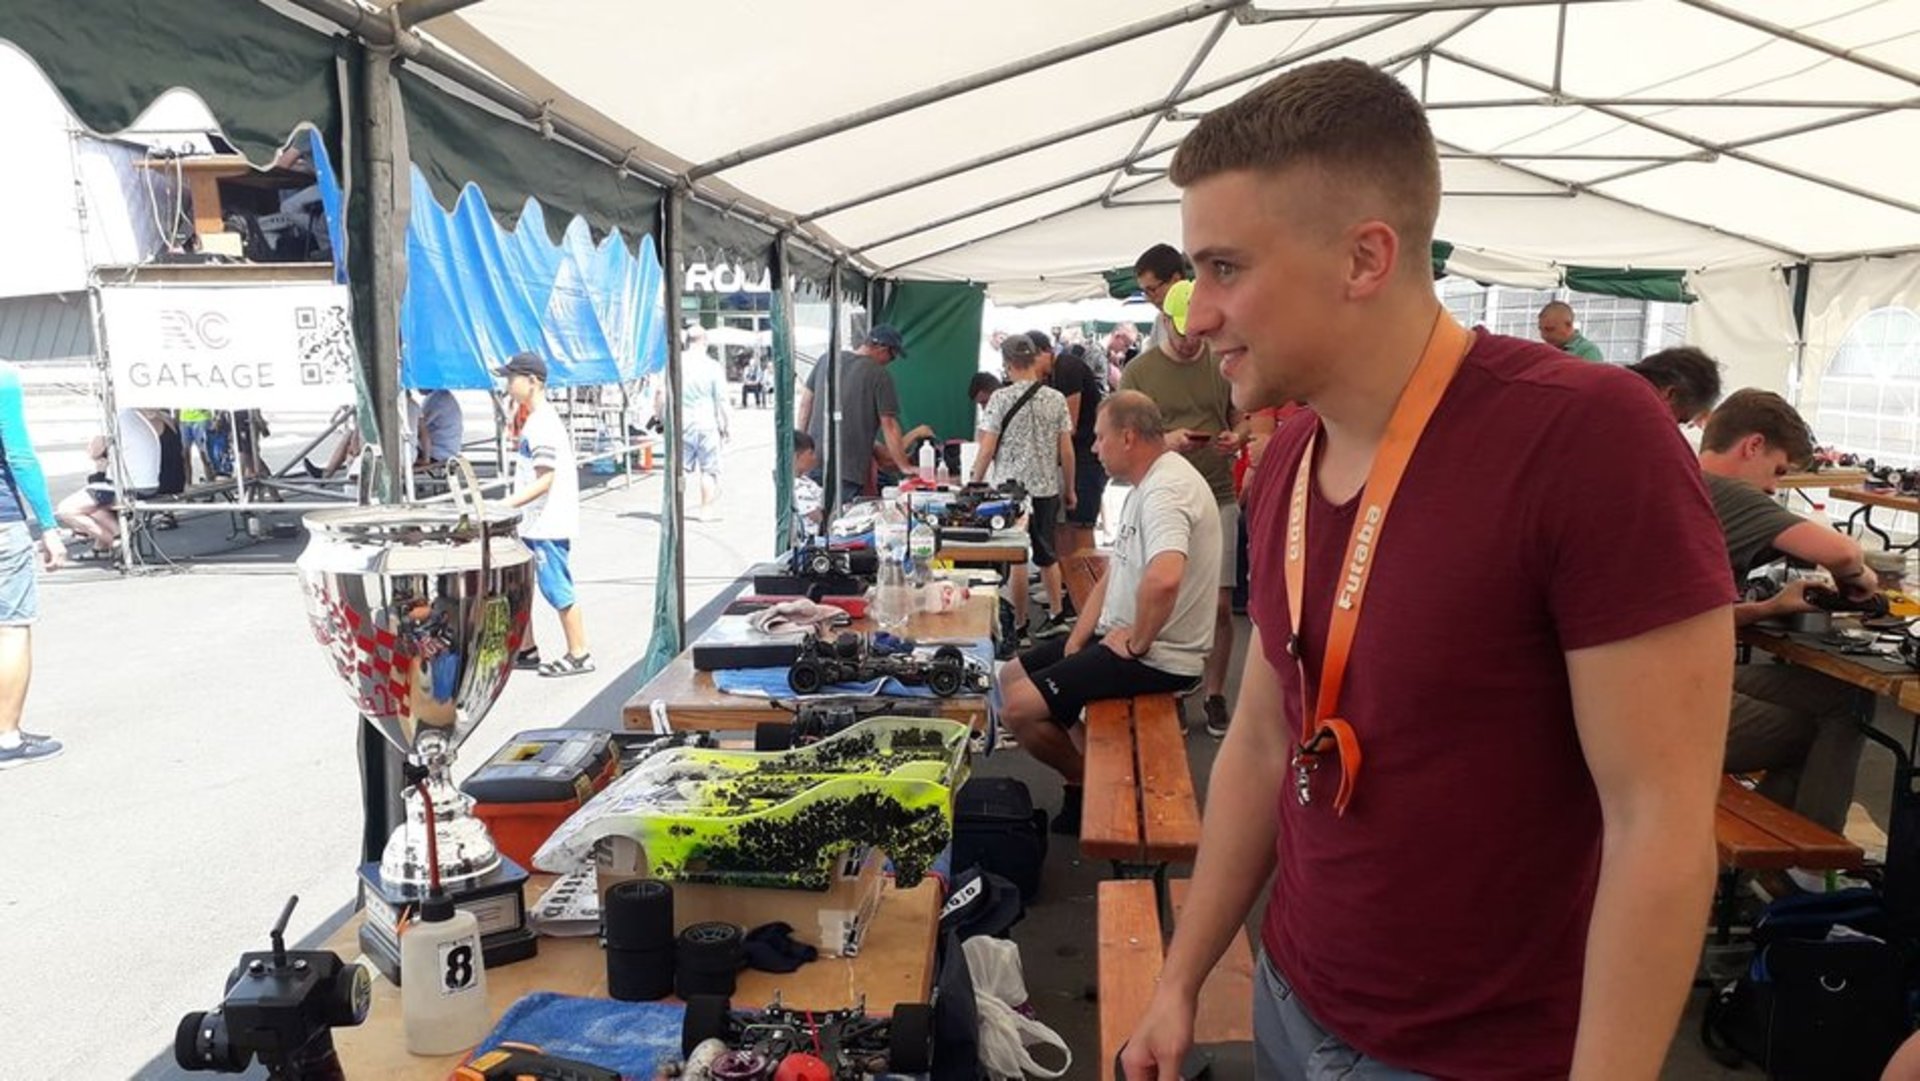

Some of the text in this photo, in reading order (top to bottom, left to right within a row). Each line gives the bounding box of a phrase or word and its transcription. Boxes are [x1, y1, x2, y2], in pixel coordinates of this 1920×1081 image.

[128, 361, 275, 389] GARAGE
[1338, 504, 1382, 611] Futaba
[445, 945, 473, 989] 8
